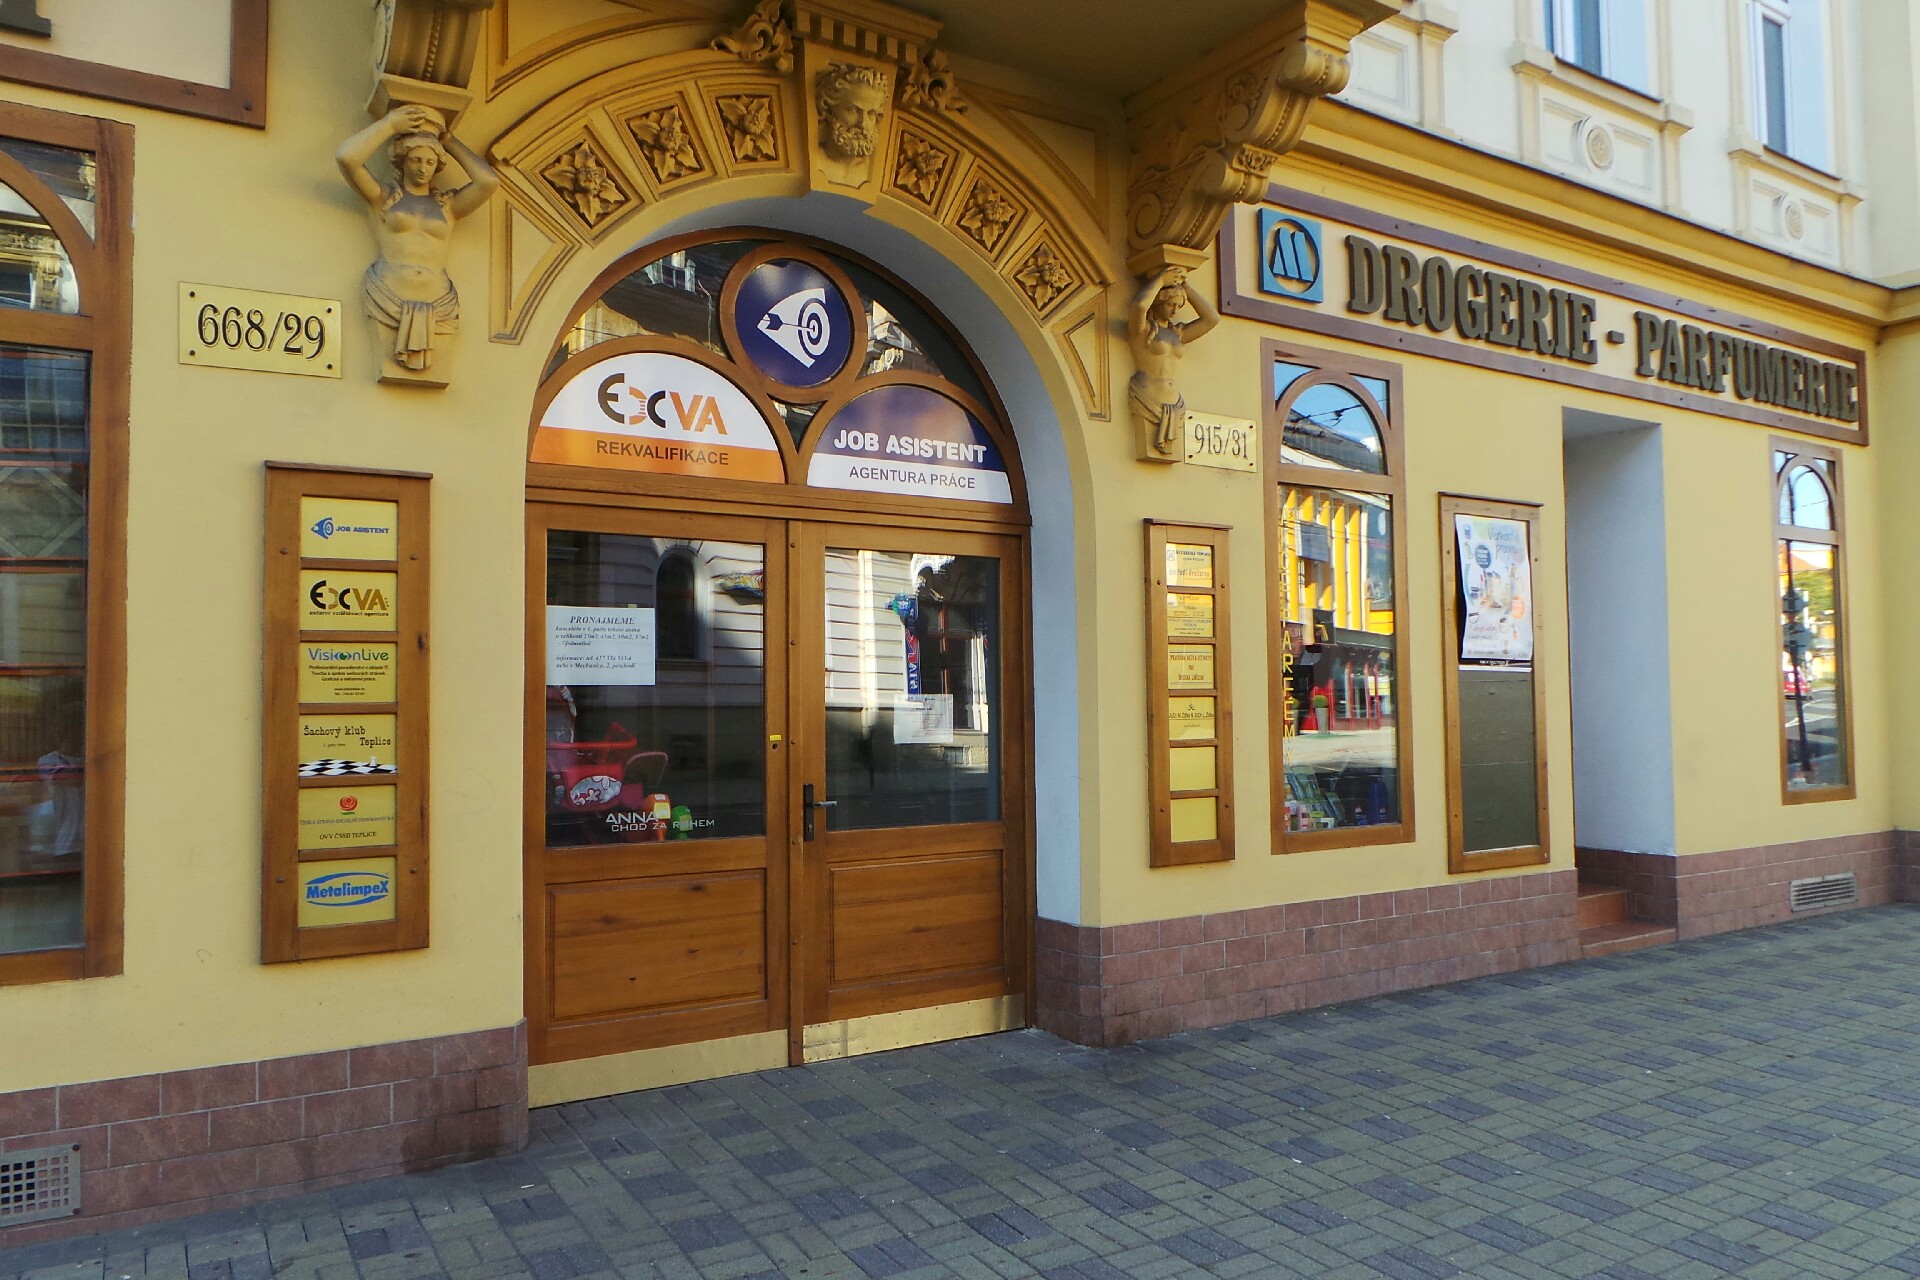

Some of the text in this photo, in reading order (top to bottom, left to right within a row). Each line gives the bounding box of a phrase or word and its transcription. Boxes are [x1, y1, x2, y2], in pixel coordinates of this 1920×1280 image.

[197, 303, 326, 361] 668/29
[1345, 233, 1598, 365] DROGERIE
[1634, 310, 1859, 423] PARFUMERIE
[833, 429, 987, 464] JOB ASISTENT
[1194, 423, 1249, 460] 915/31
[596, 439, 729, 466] REKVALIFIKACE
[849, 466, 976, 490] AGENTURA PRÁCE
[335, 525, 390, 535] JOB ASISTENT
[569, 615, 636, 625] PRONAJMEME
[303, 724, 366, 739] Šachový klub
[359, 736, 392, 749] Teplice
[605, 811, 659, 825] ANNA
[611, 822, 648, 832] CHOD
[652, 822, 668, 830] ZA
